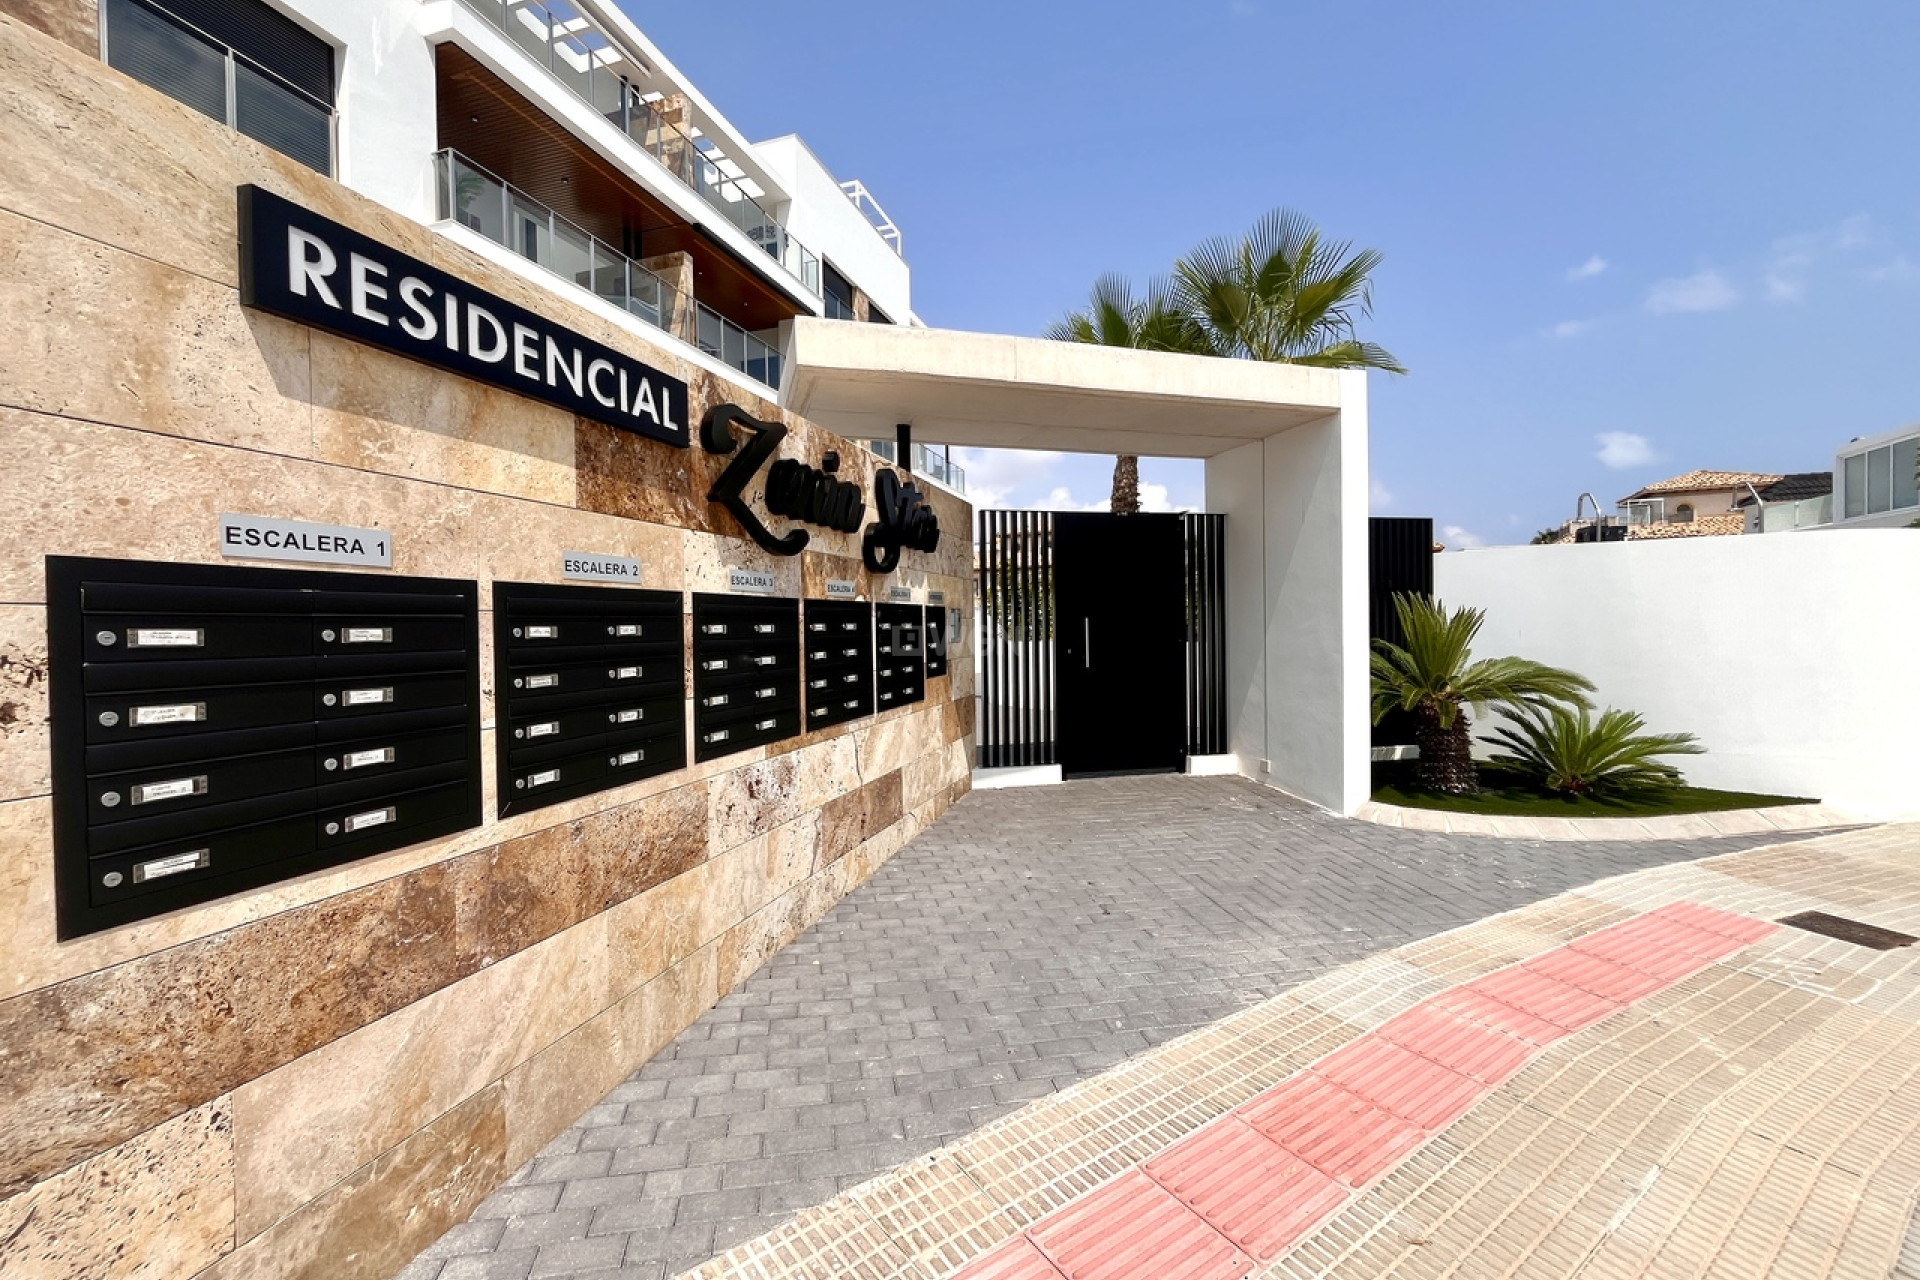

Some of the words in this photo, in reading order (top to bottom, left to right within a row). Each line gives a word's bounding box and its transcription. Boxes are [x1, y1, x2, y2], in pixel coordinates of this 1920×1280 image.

[288, 225, 678, 430] RESIDENCIAL
[225, 526, 365, 555] ESCALERA
[376, 541, 386, 557] 1
[564, 560, 628, 576] ESCALERA
[631, 565, 639, 577] 2
[731, 575, 766, 586] ESCALERA
